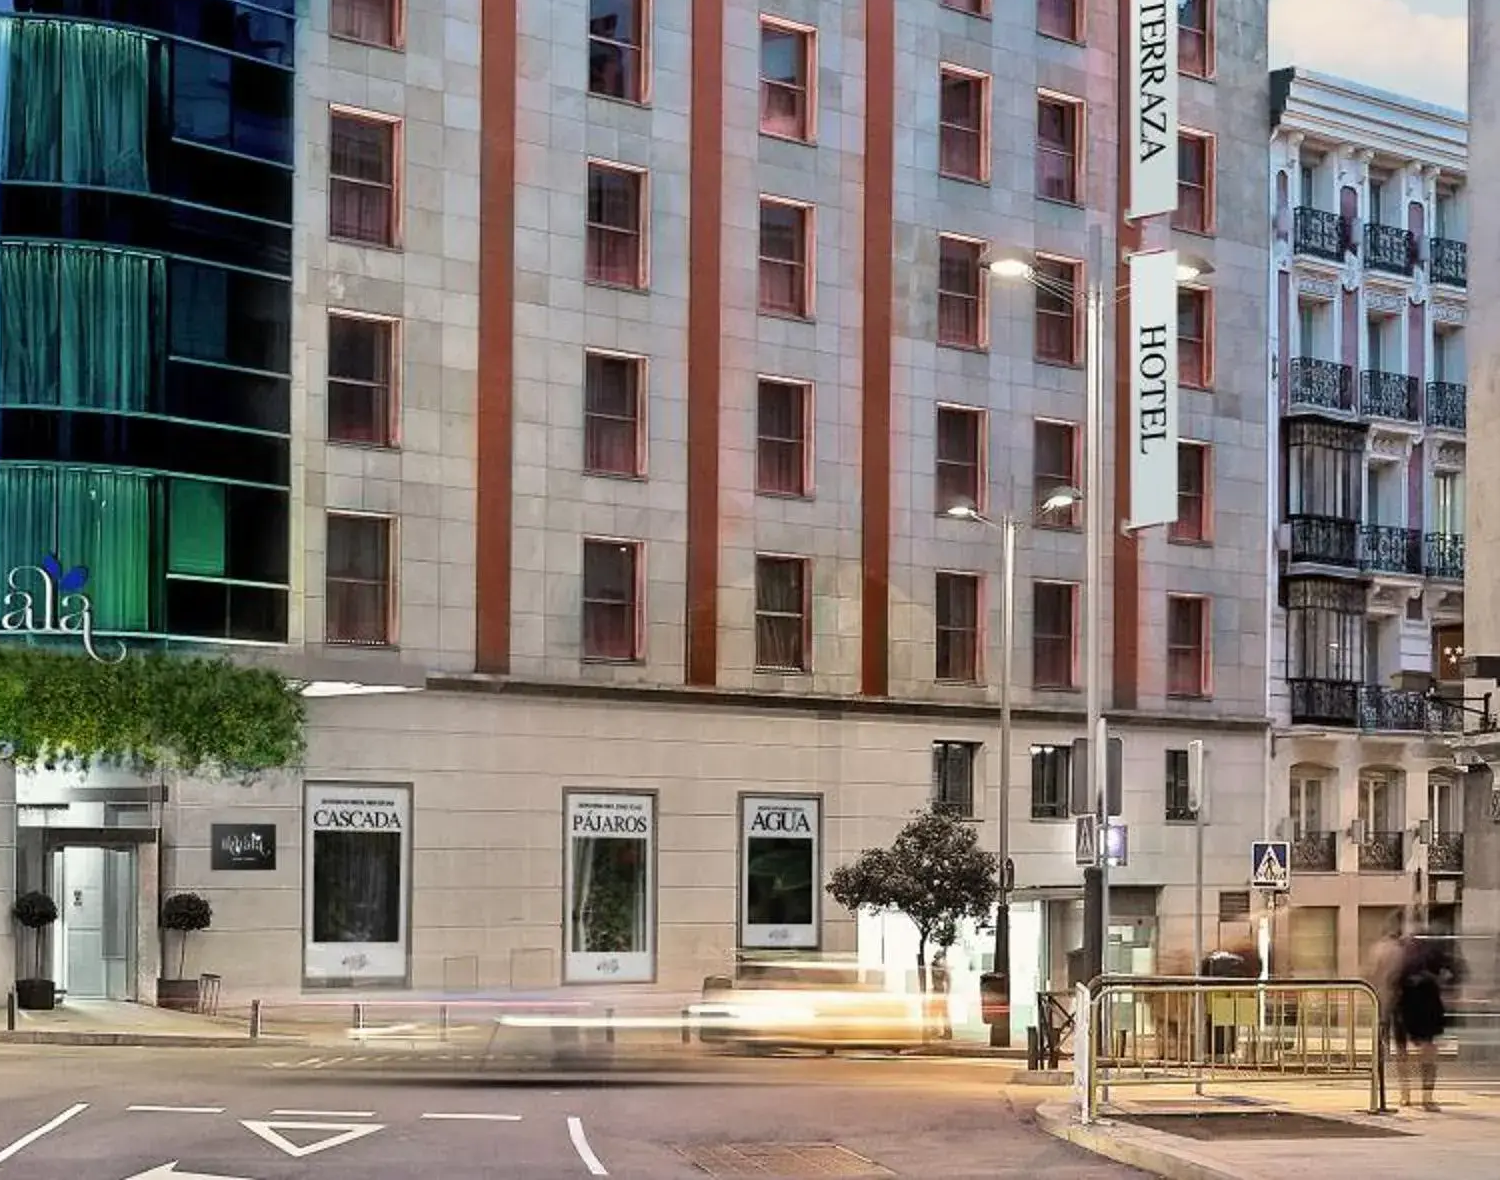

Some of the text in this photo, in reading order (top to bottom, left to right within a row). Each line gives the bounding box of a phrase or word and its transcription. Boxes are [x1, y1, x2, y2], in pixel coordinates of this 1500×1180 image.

[1139, 323, 1168, 456] HOTEL
[313, 809, 402, 829] CASCADA
[572, 810, 648, 833] PÁJAROS
[750, 811, 811, 832] AGUA
